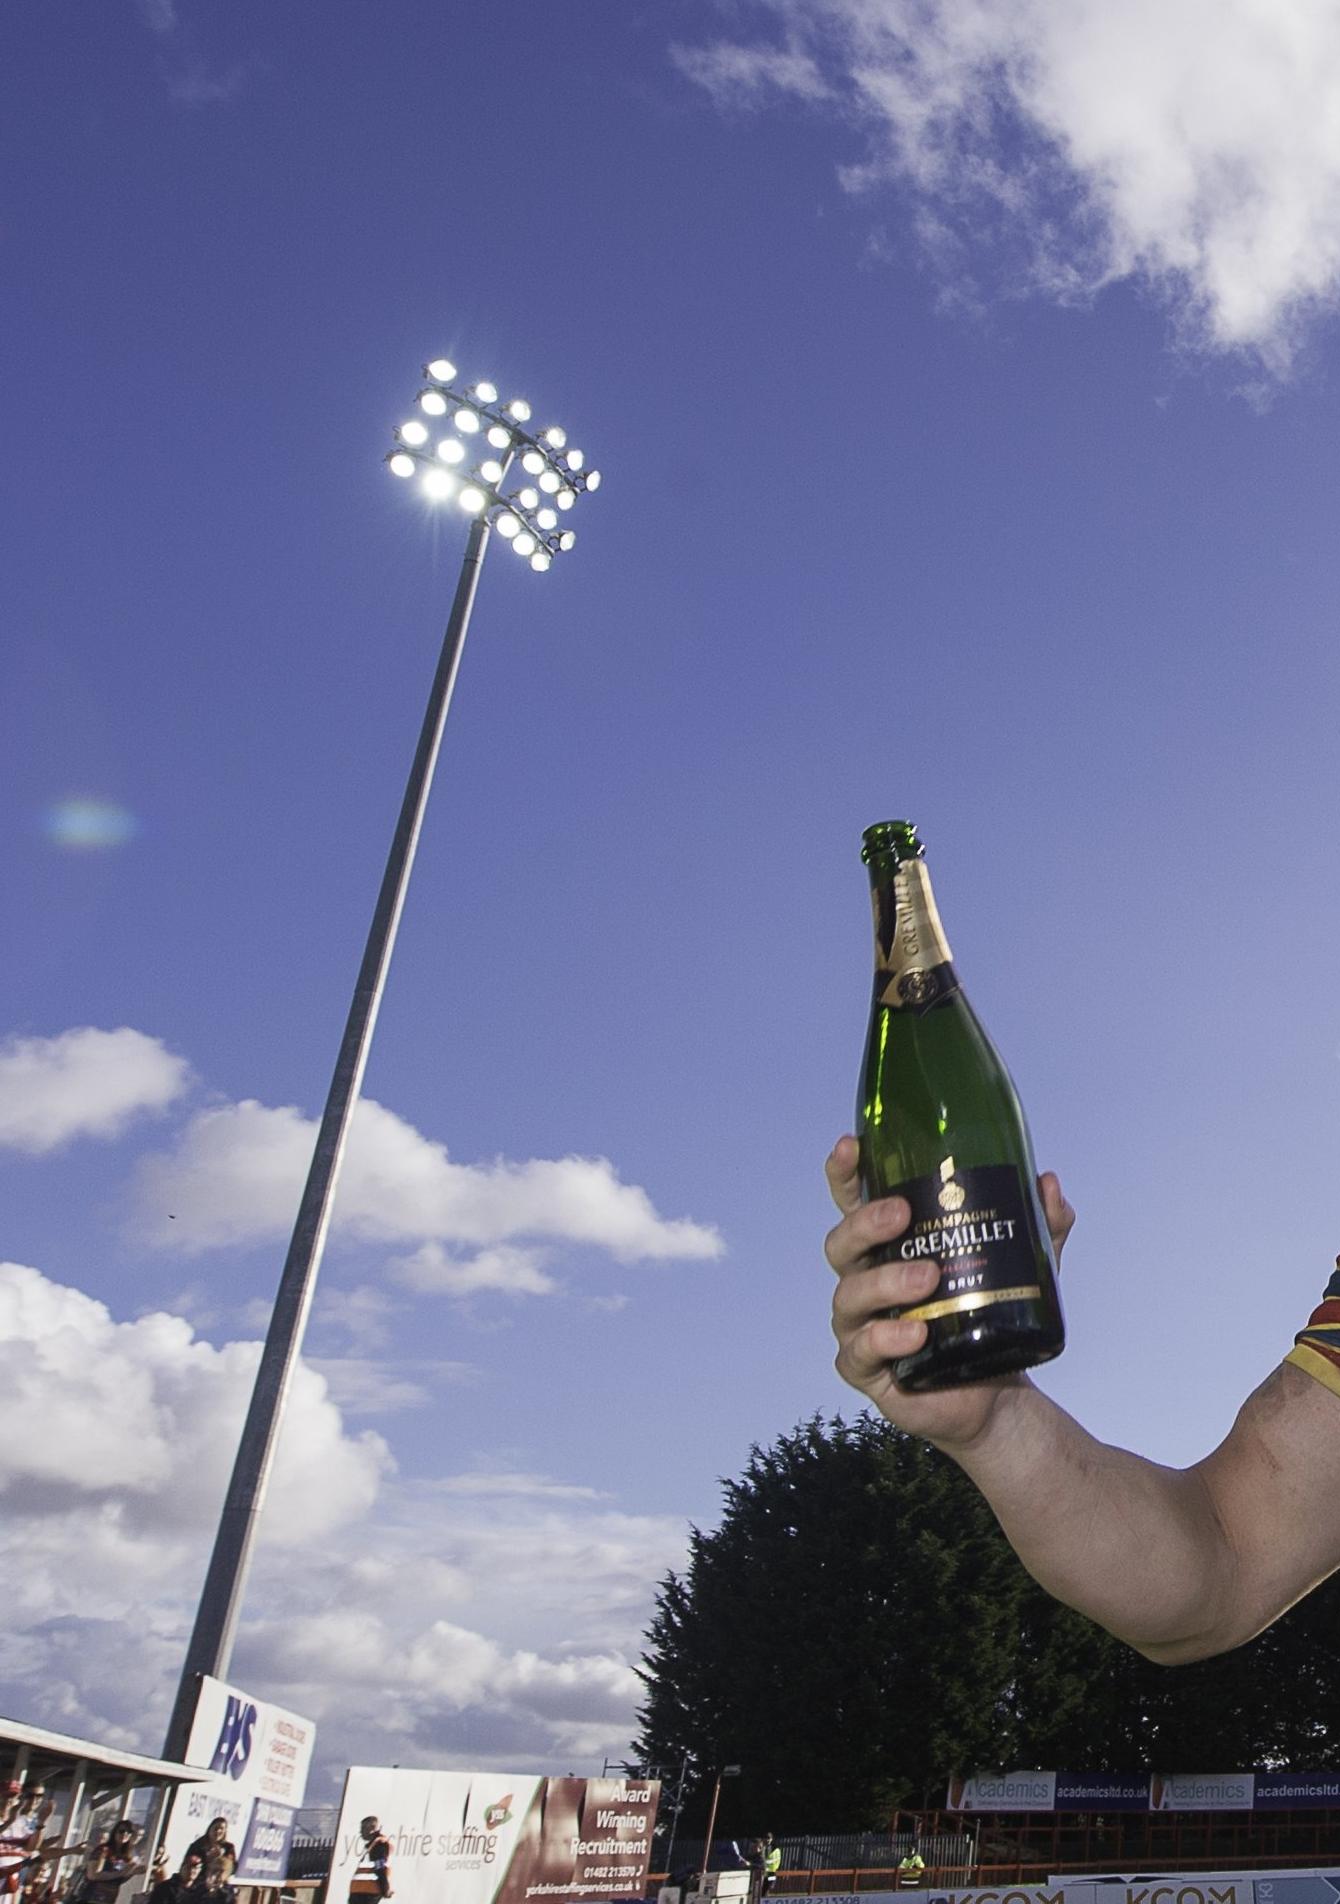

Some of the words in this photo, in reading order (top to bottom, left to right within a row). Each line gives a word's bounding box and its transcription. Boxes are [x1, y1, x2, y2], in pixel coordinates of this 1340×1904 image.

[900, 1219, 1015, 1260] GREMILLET
[947, 1273, 984, 1292] BRUT
[1056, 1783, 1148, 1799] academicsltd.co.uk
[437, 1827, 498, 1864] staffing
[570, 1836, 647, 1855] Recruitment
[583, 1867, 607, 1879] 01482
